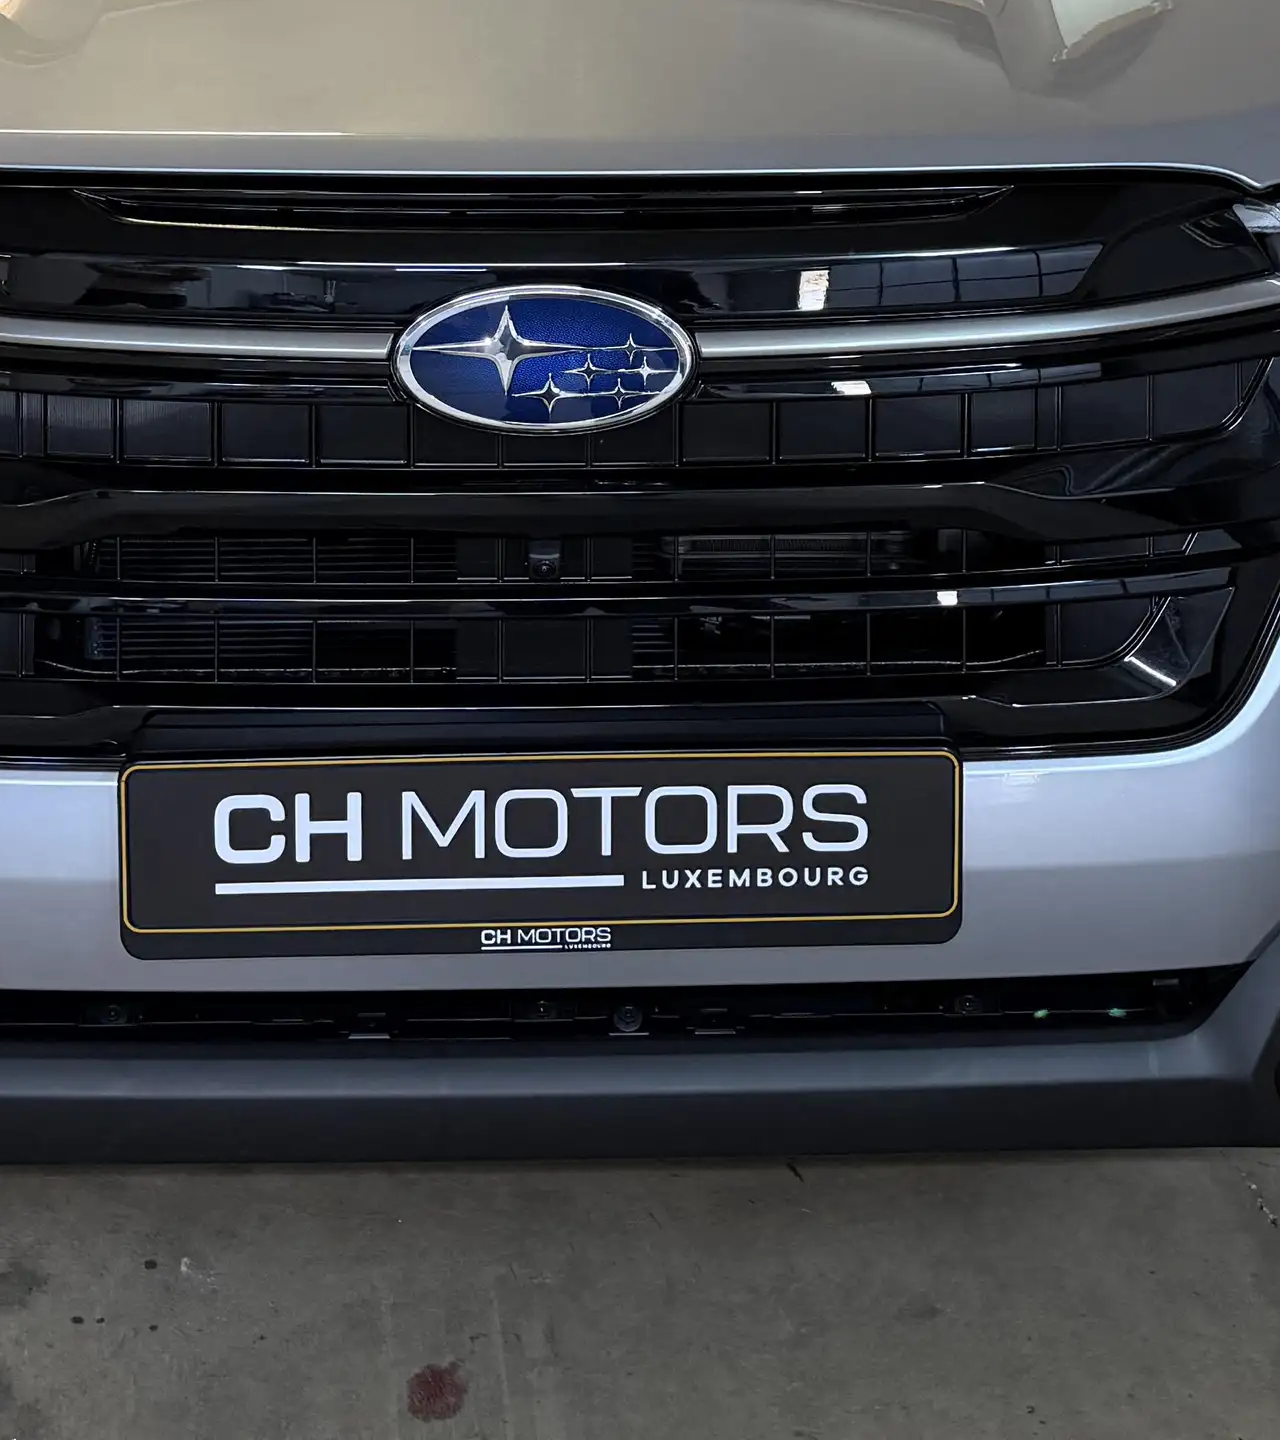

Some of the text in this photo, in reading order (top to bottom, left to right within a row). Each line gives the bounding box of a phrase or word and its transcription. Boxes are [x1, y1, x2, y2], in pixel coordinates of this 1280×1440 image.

[213, 783, 870, 865] CH MOTORS
[641, 866, 870, 891] LUXEMBOURG
[480, 926, 612, 945] CH MOTORS
